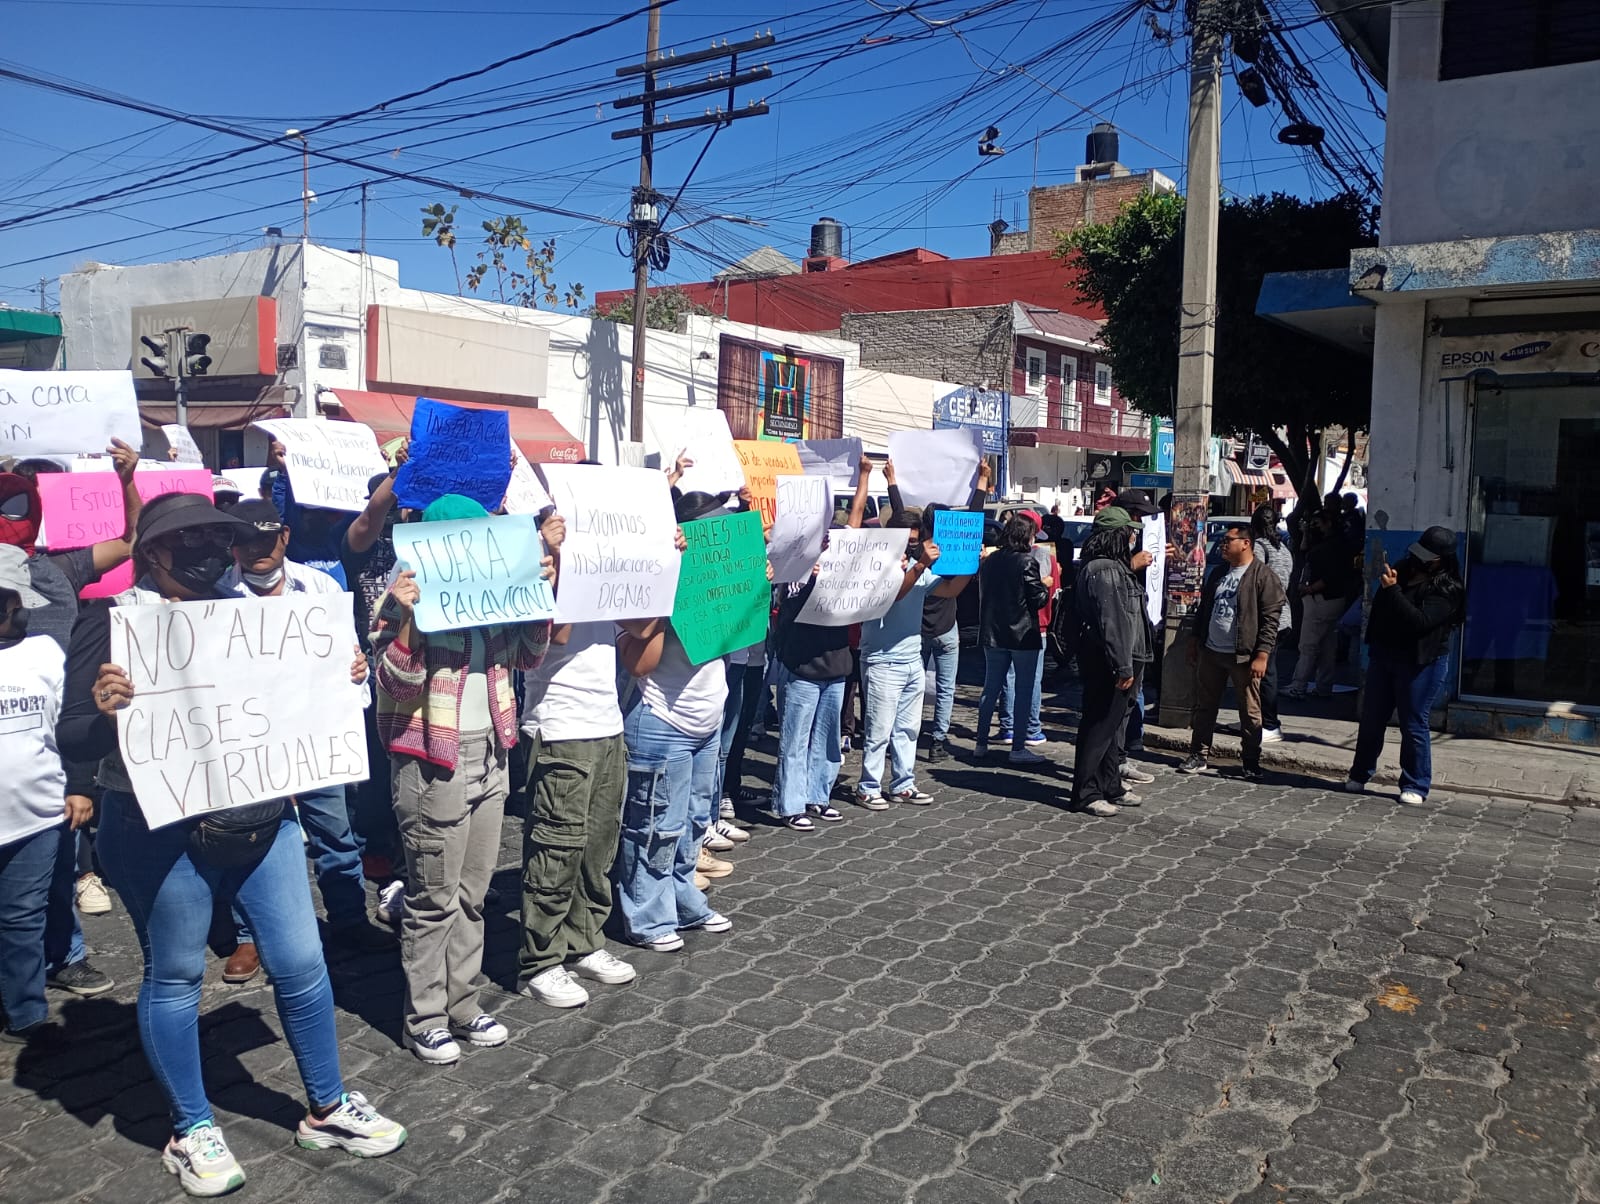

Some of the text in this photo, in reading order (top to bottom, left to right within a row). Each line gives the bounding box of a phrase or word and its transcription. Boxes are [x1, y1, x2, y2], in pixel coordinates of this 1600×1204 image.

[1441, 350, 1495, 365] EPSON
[32, 385, 92, 407] cara
[66, 520, 118, 540] ES UN
[412, 527, 511, 584] FUERA
[823, 561, 846, 572] eres
[869, 556, 882, 572] la
[597, 582, 652, 613] DIGNAS
[863, 579, 876, 591] es
[882, 580, 893, 589] su
[440, 582, 553, 625] PALAVICINI
[125, 697, 271, 766] CLASES
[159, 730, 364, 817] VIRTUALES
